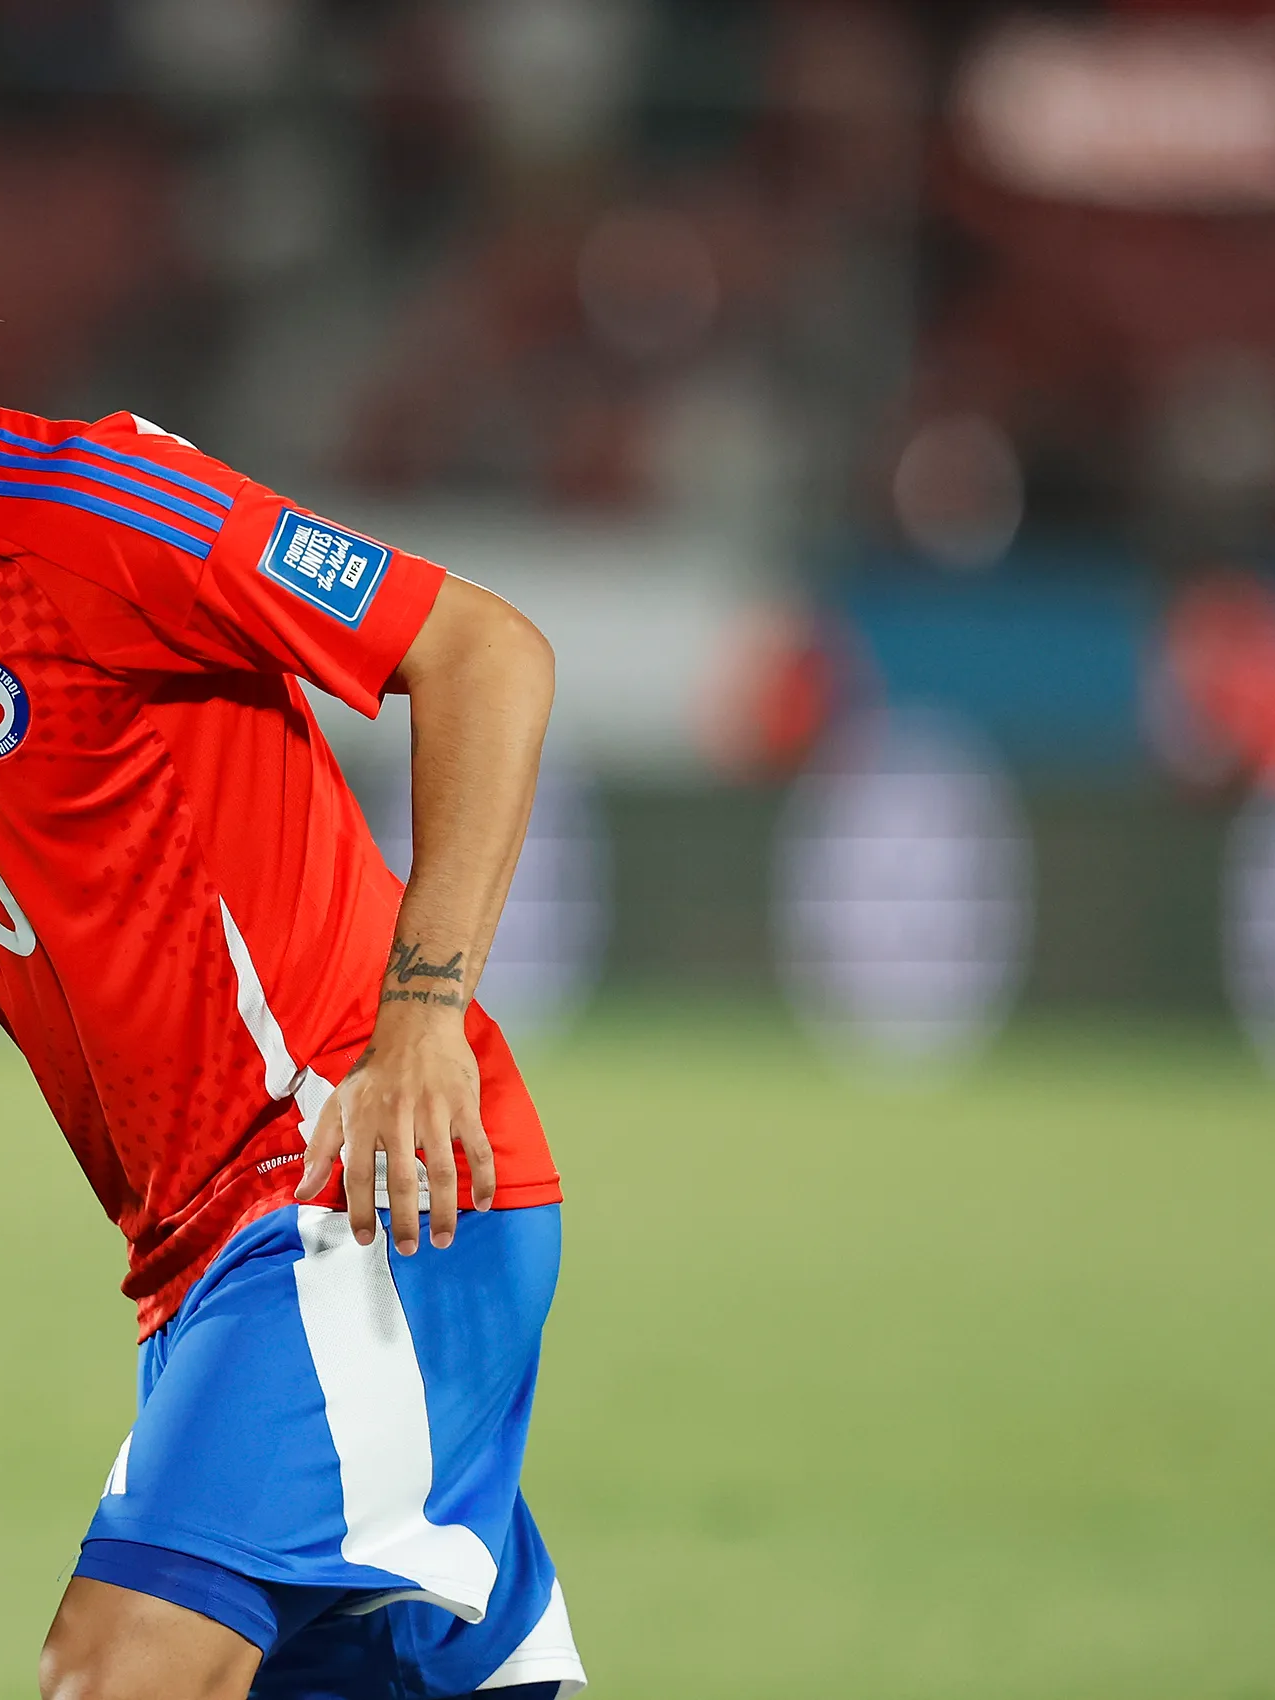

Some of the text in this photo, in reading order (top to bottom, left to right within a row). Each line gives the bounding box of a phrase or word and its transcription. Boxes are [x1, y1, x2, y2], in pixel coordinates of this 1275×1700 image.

[283, 525, 312, 568] FOOTBALL
[297, 530, 333, 578] UNITES
[317, 536, 353, 591] the World
[346, 561, 362, 582] FIFA
